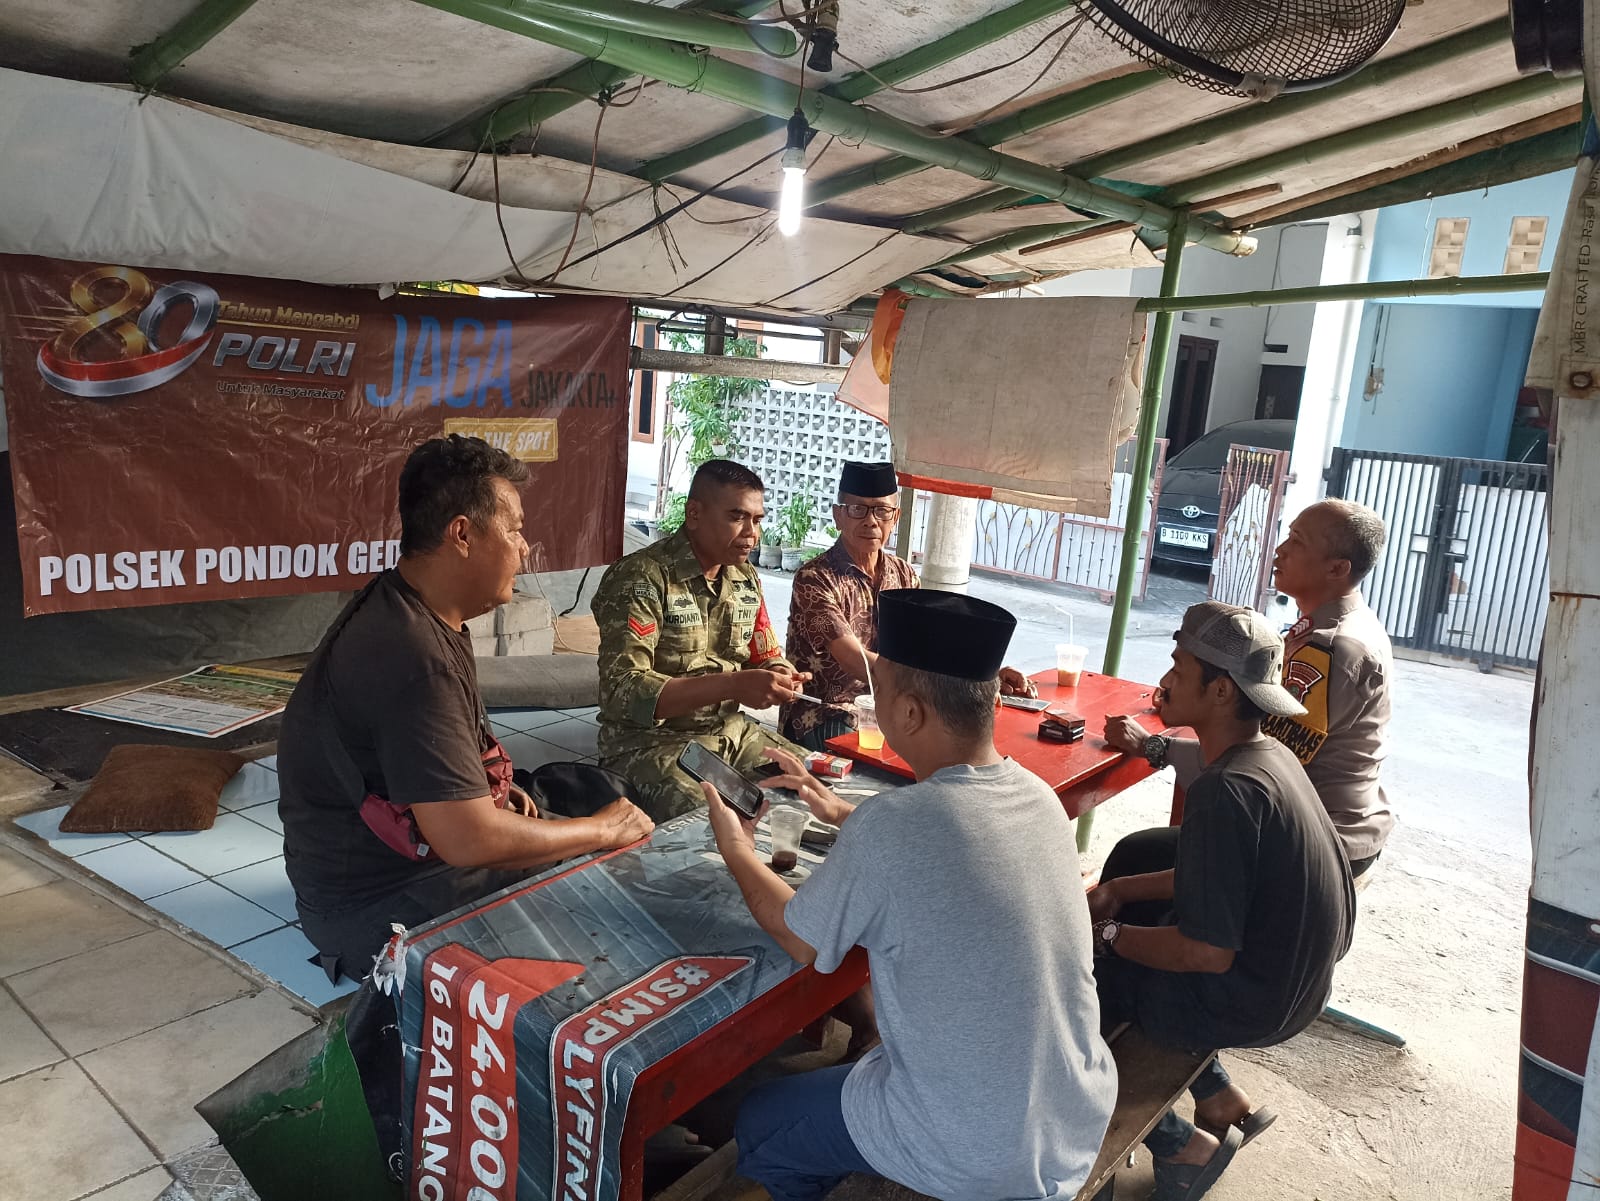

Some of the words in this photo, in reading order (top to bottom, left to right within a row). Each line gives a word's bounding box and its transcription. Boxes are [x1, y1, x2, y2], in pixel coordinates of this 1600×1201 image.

[218, 300, 271, 322] Tahun
[274, 306, 360, 329] Mengabdi
[213, 333, 357, 376] POLRI
[365, 314, 514, 409] JAGA
[217, 381, 260, 395] Untuk
[263, 384, 345, 399] Masyarakat
[484, 431, 513, 453] THE
[514, 431, 551, 452] SPOT
[1162, 528, 1167, 537] B
[40, 550, 186, 596] POLSEK
[196, 543, 339, 585] PONDOK
[348, 539, 401, 575] GED
[430, 960, 459, 1009] 16
[563, 962, 712, 1201] #SIMPLYFIN
